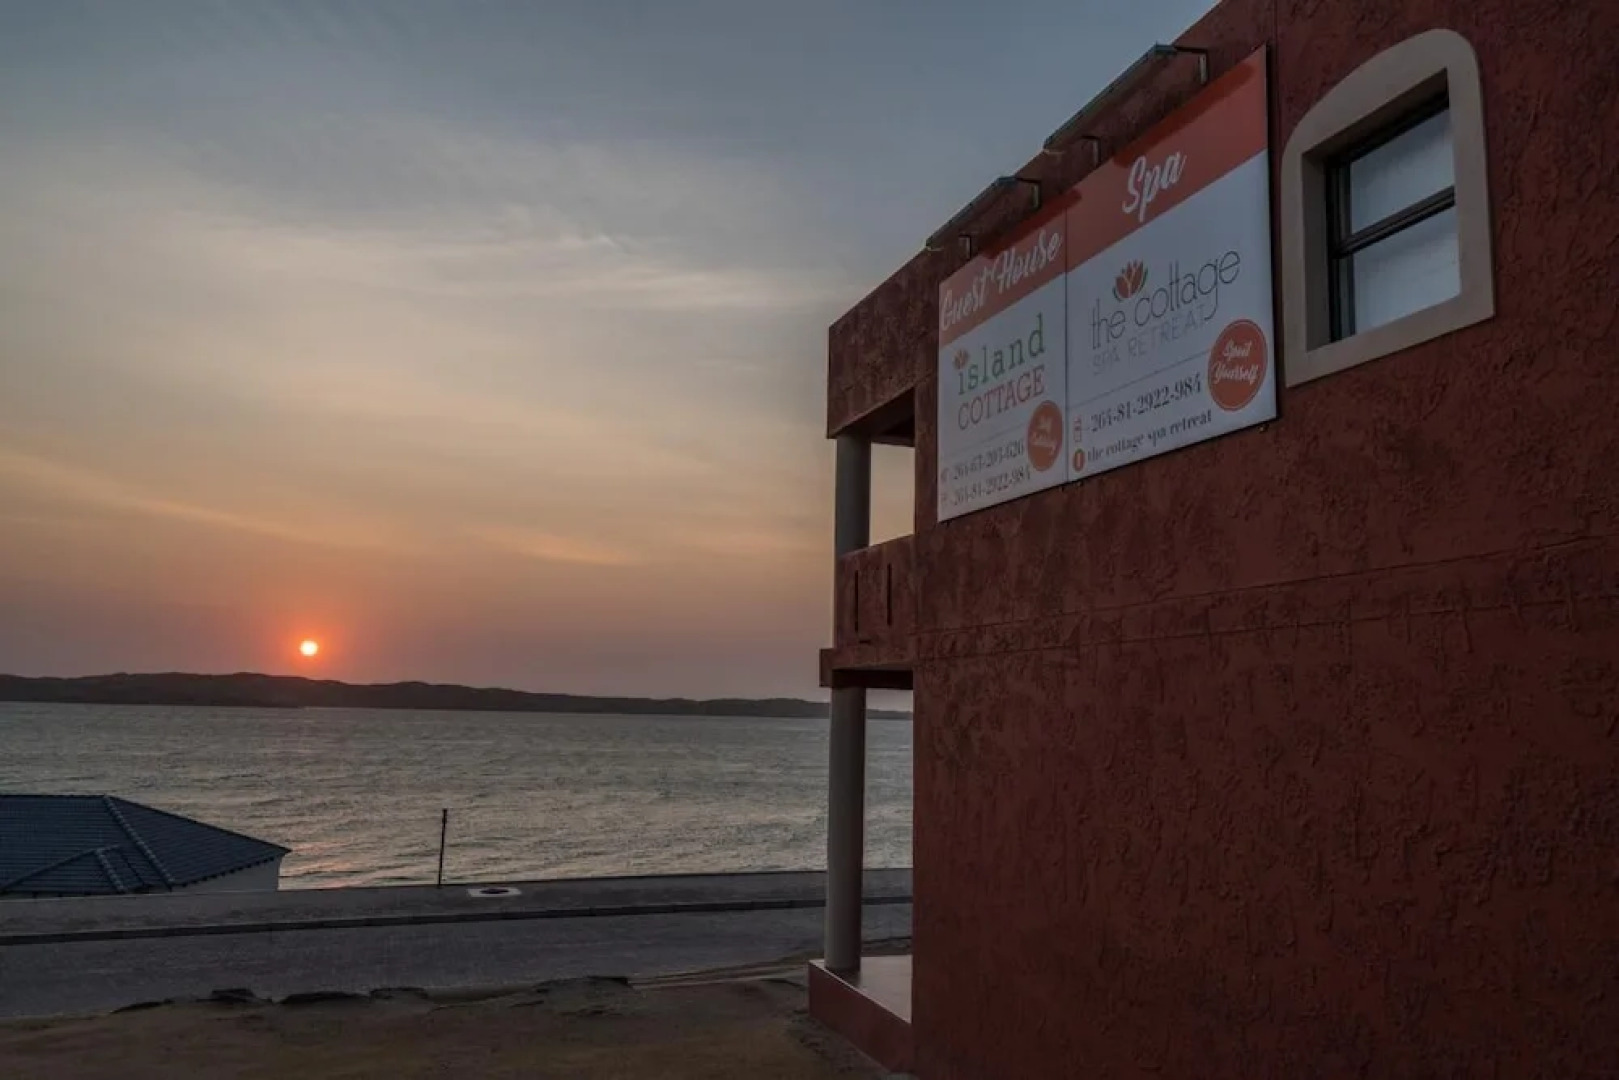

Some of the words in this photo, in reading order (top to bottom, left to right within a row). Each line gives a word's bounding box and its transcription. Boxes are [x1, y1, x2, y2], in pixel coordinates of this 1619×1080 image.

[1122, 151, 1187, 222] Spa
[940, 265, 989, 331] Guest
[990, 229, 1061, 293] House
[1090, 297, 1126, 350] the
[1134, 250, 1240, 326] cottage
[958, 312, 1044, 395] island
[1092, 346, 1120, 376] SPA
[1128, 302, 1211, 358] RETREAT
[958, 364, 1045, 430] COTTAGE
[1087, 445, 1104, 463] the
[1105, 431, 1145, 457] cottage
[1148, 426, 1167, 448] spa
[1170, 409, 1213, 436] retreat
